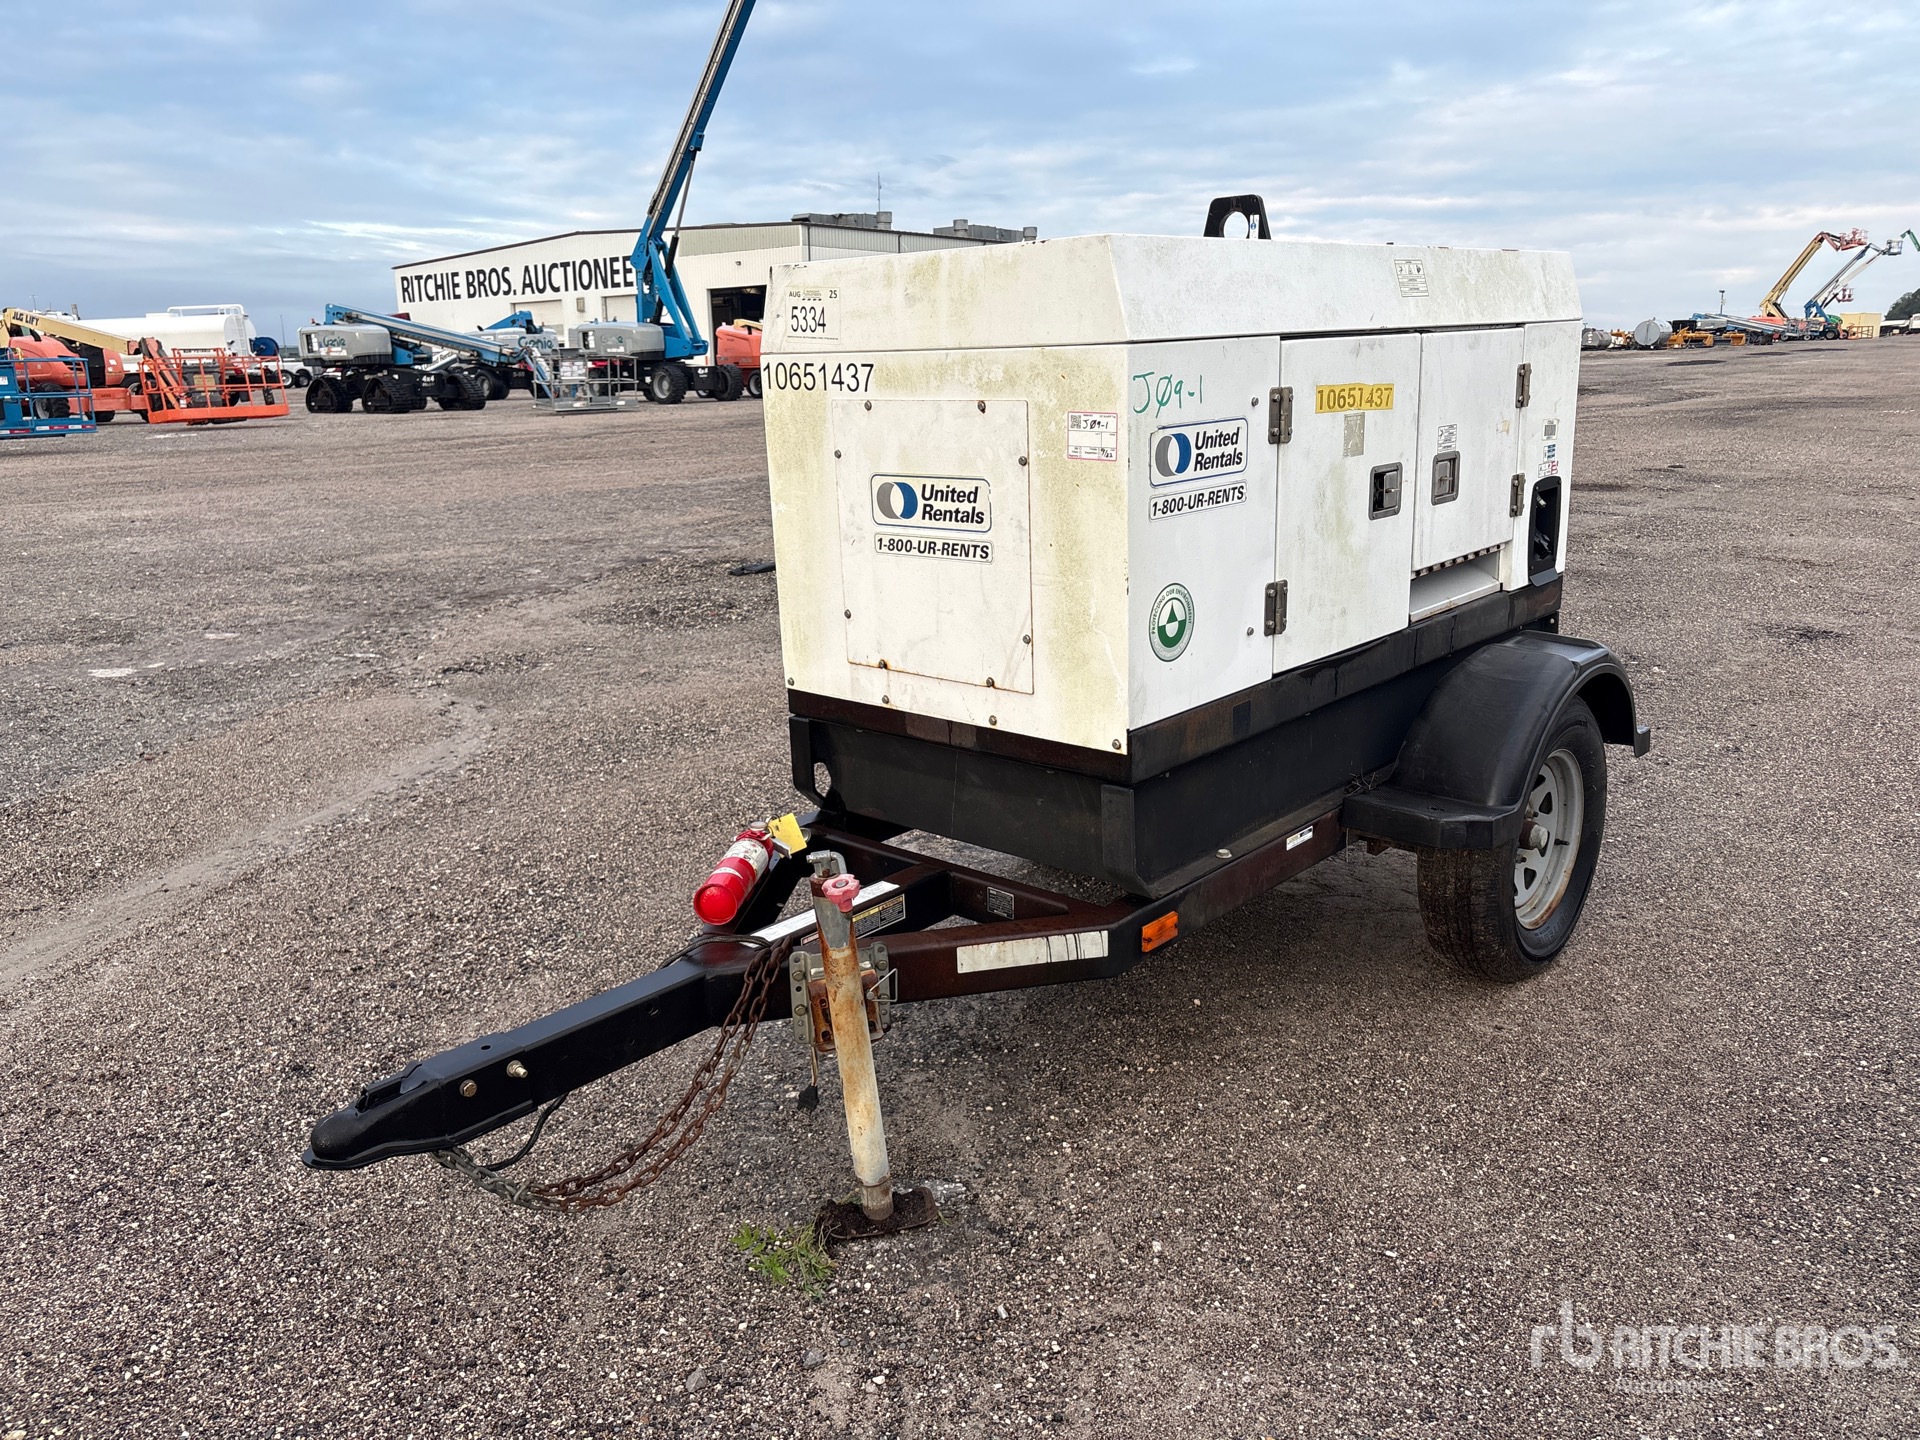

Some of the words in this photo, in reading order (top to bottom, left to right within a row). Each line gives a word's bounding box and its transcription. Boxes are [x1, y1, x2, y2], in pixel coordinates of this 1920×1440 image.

[400, 271, 461, 303] RITCHIE
[465, 266, 517, 299] BROS.
[521, 255, 634, 296] AUCTIONEE
[829, 289, 838, 299] 25
[12, 311, 24, 323] JLG
[25, 314, 40, 326] LIFT
[791, 306, 826, 333] 5334
[323, 335, 346, 348] Genie
[517, 336, 554, 349] Genie
[763, 361, 875, 393] 10651437
[1317, 387, 1393, 411] 10651437
[1195, 426, 1241, 451] United
[1193, 447, 1243, 472] Rentals
[921, 483, 979, 504] United
[1152, 485, 1245, 517] 1-800-UR-RENTS
[921, 503, 985, 525] Rentals
[877, 537, 990, 560] 1-800-UR-RENTS
